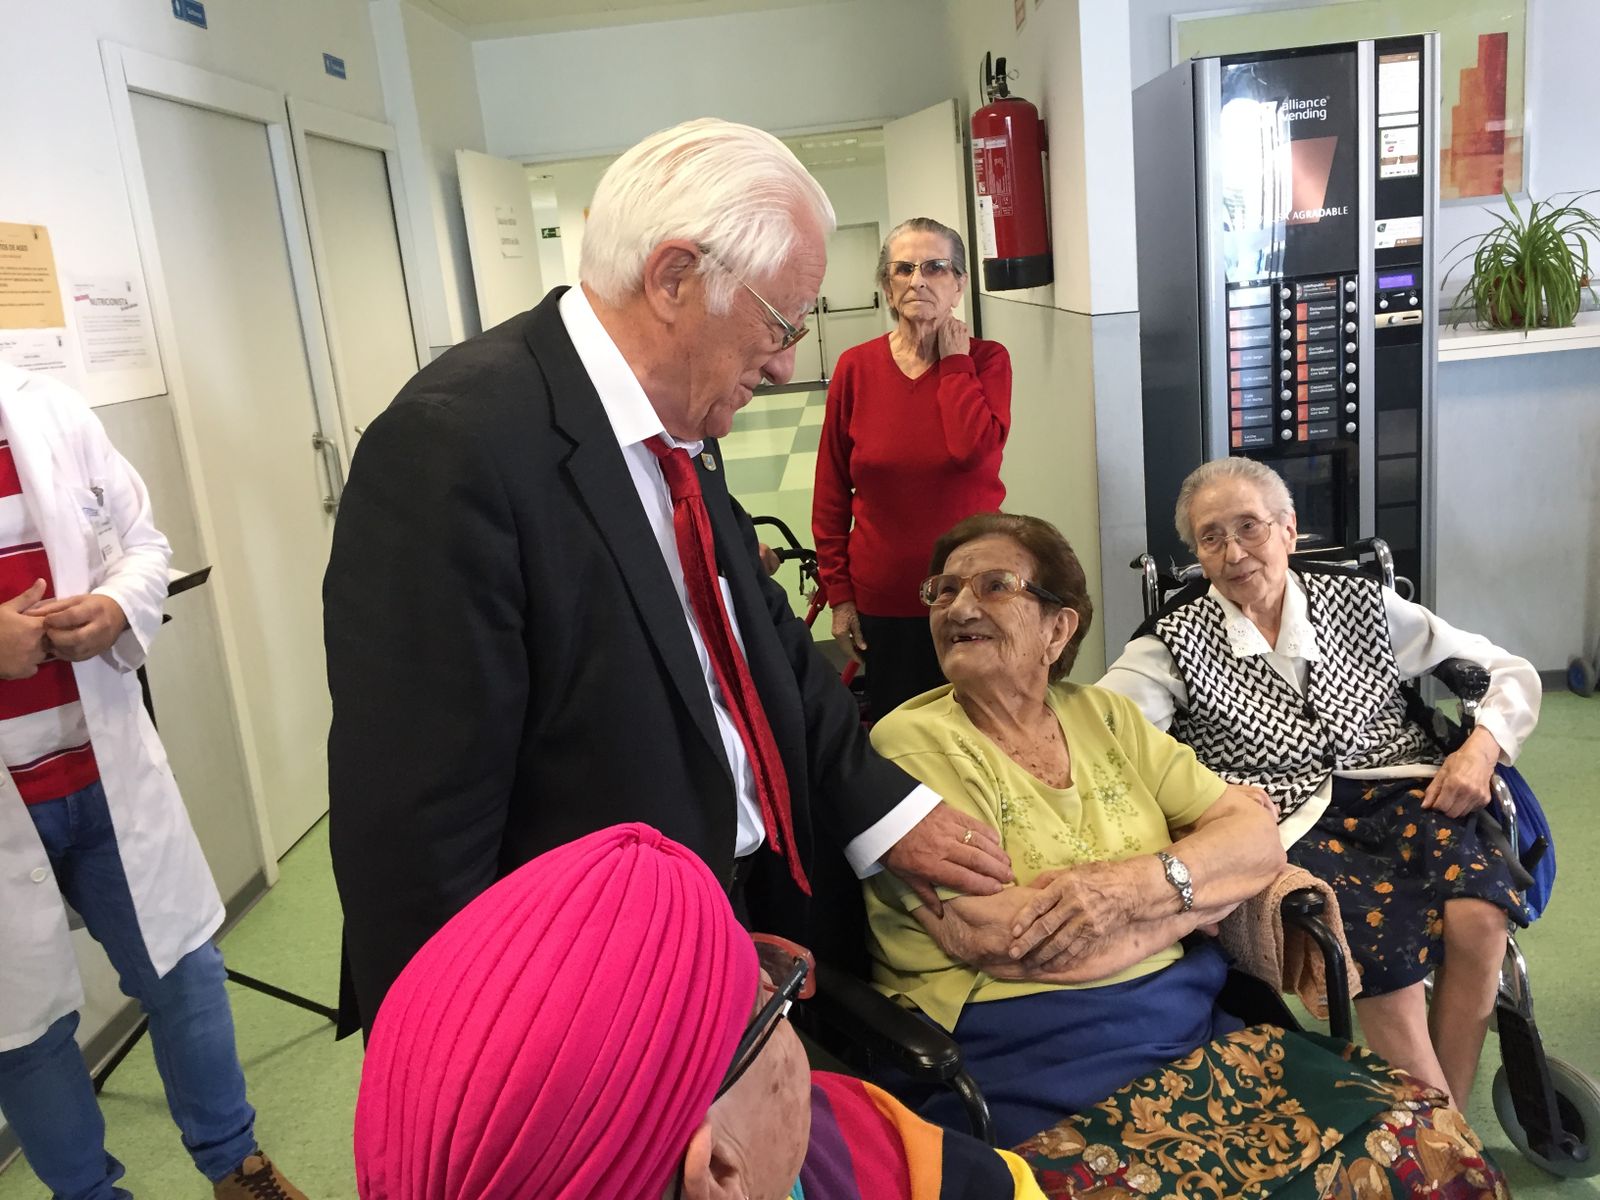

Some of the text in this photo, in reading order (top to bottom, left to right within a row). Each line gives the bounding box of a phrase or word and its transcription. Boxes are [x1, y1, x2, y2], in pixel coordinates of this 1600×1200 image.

[1282, 98, 1327, 110] alliance
[1281, 108, 1327, 121] vending
[1292, 205, 1349, 220] AGRADABLE
